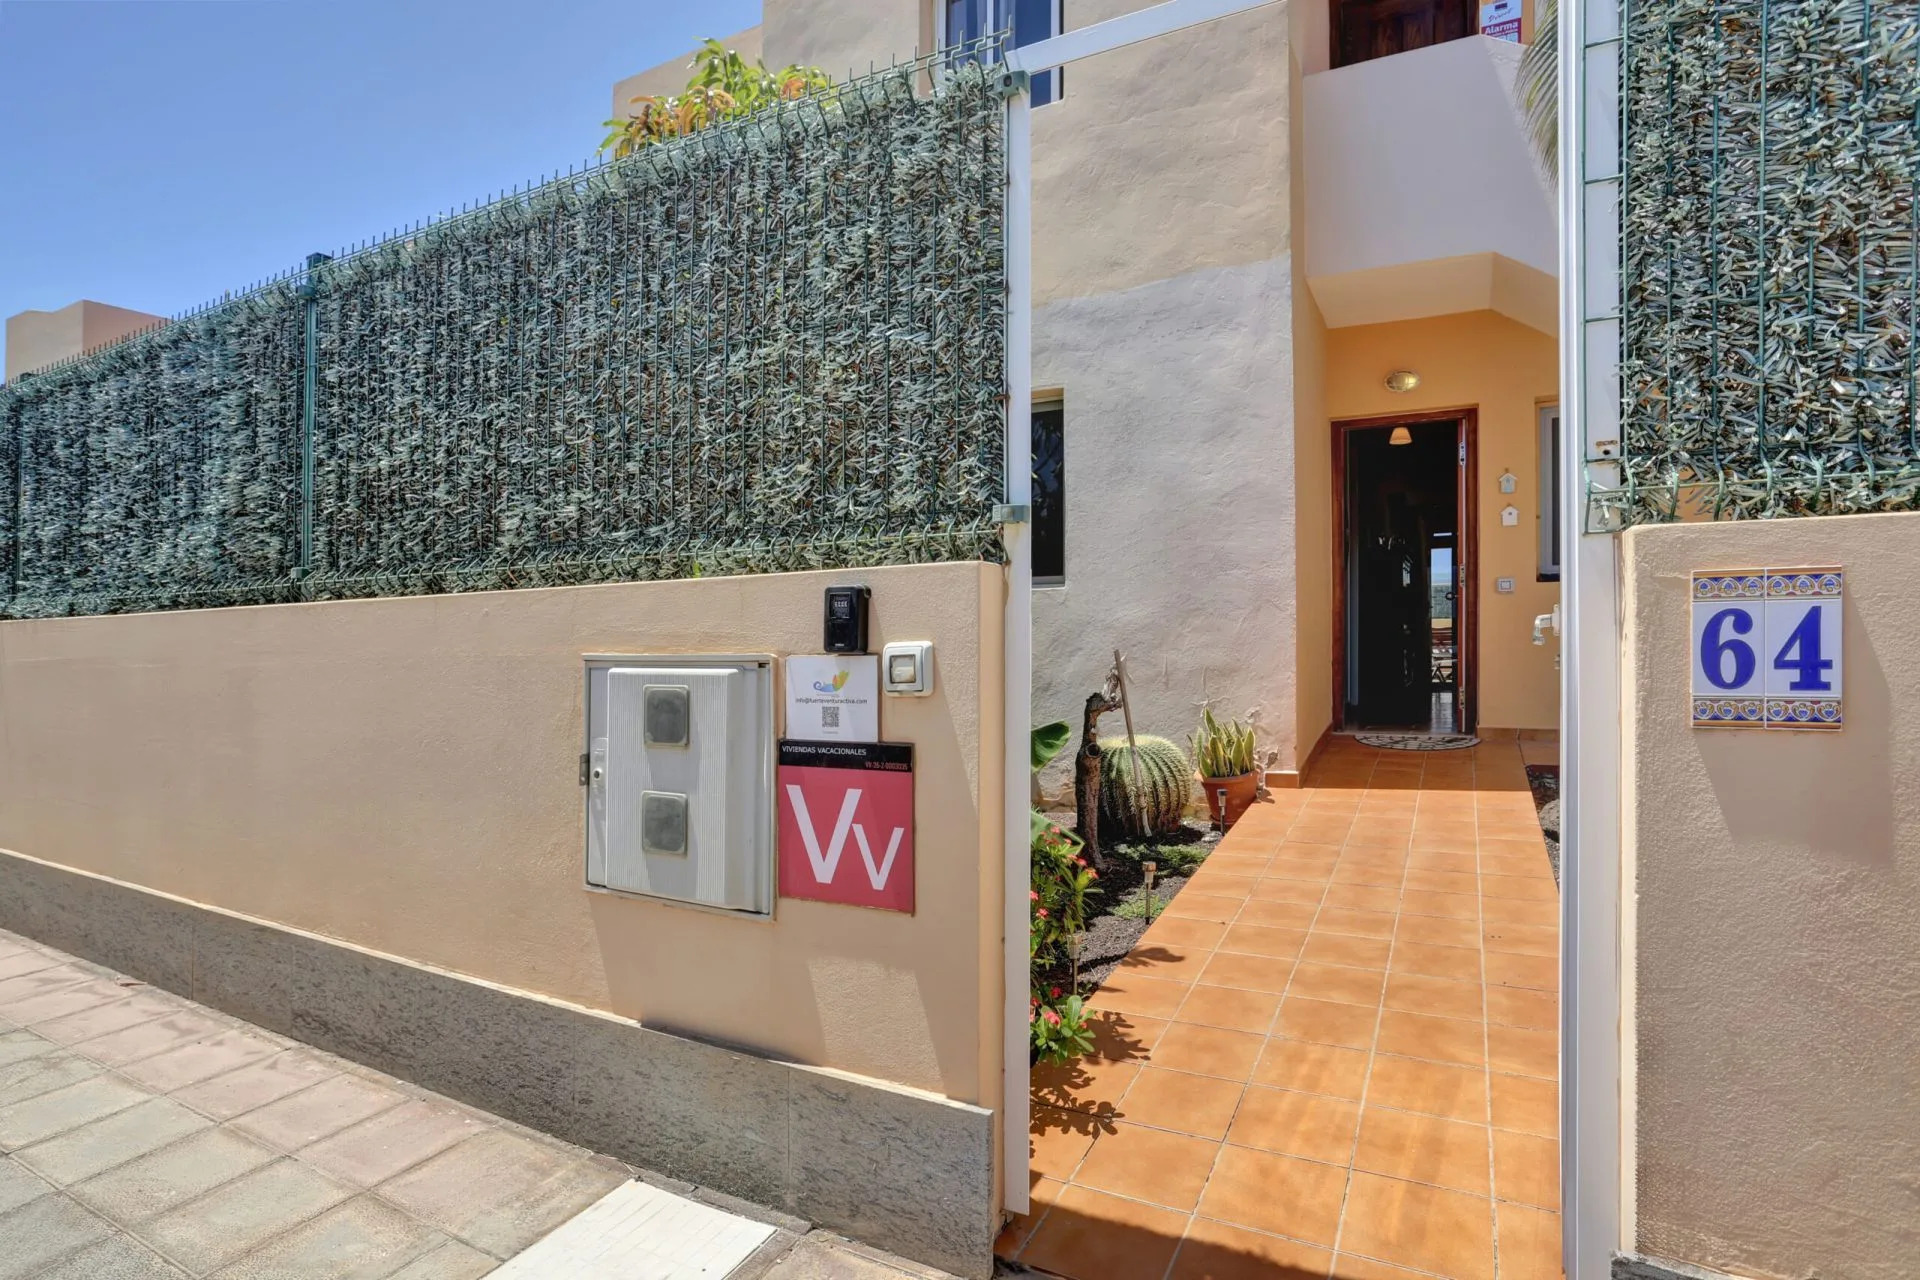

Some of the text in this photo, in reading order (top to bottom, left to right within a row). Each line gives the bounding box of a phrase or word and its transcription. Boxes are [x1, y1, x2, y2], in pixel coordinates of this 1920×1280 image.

[1485, 21, 1519, 35] Alarma
[1701, 606, 1833, 691] 64
[781, 745, 867, 756] VIVIENDAS VACACIONALES
